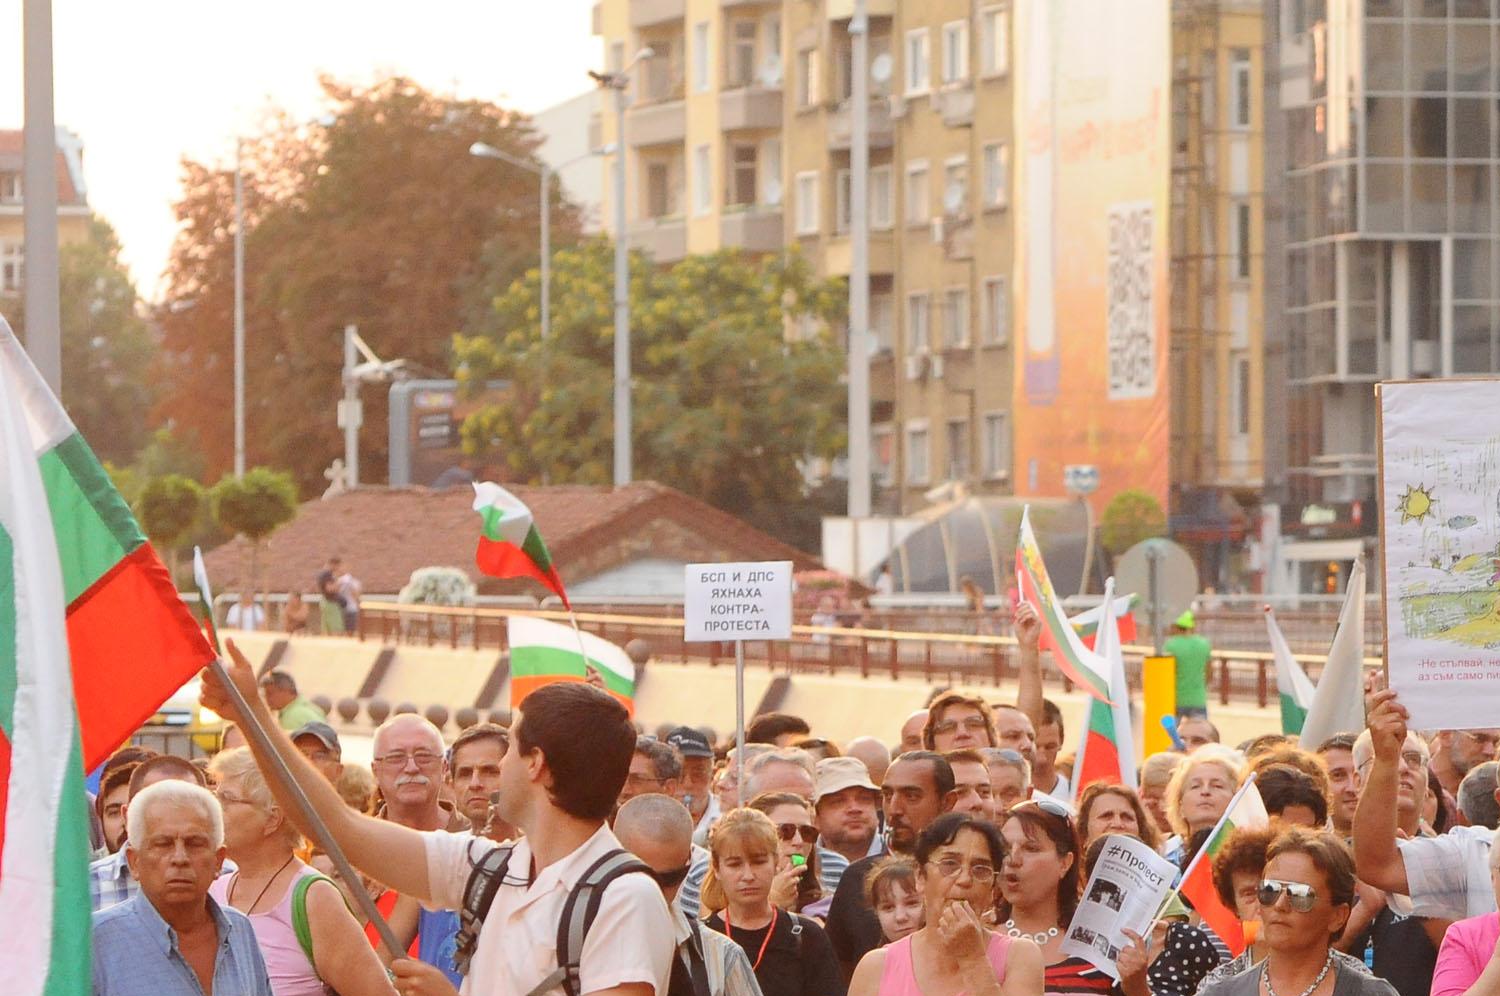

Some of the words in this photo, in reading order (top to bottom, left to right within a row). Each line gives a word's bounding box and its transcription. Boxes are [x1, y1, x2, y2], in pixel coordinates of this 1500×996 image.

[700, 572, 726, 583] БСП
[732, 572, 741, 581] И
[747, 571, 775, 583] ДПС
[711, 587, 762, 599] ЯХНАХА
[710, 604, 764, 615] КОНТРА-
[704, 620, 771, 632] ПРОТЕСТА
[1432, 672, 1454, 681] съм
[1456, 671, 1484, 680] само
